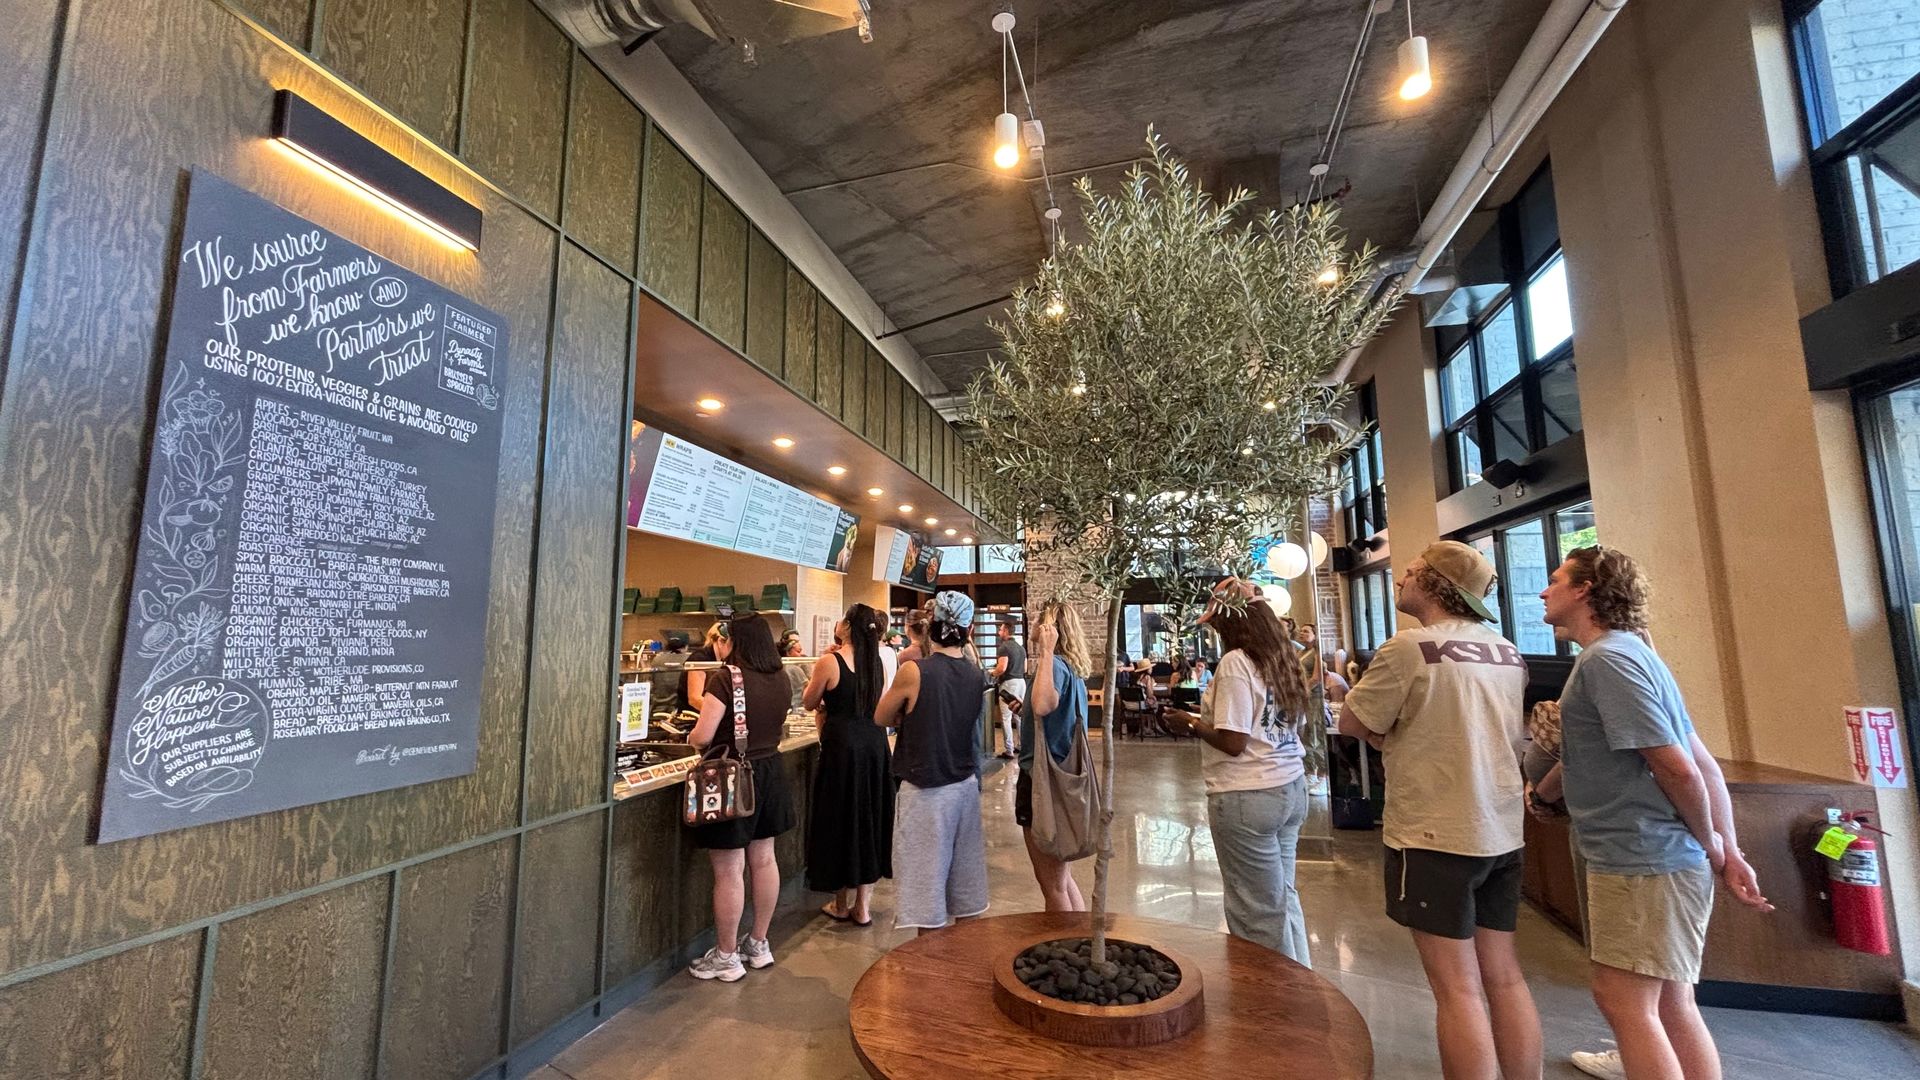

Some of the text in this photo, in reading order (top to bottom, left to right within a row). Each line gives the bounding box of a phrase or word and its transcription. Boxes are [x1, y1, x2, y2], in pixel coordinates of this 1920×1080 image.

[183, 230, 326, 288] We source
[215, 256, 381, 348] from Farmers
[263, 281, 402, 344] we know AND
[451, 310, 492, 335] FEATURED
[453, 321, 486, 342] FARMER
[317, 303, 435, 373] Partners we
[448, 340, 483, 361] Dynasty
[458, 354, 484, 370] Farms
[206, 339, 477, 434] OUR PROTEINS, VEGGIES & GRAINS ARE COOKED
[444, 366, 474, 386] BRUSSELS
[446, 378, 474, 396] SPROUTS
[204, 354, 469, 442] USING 100% EXTRA-VIRGIN OLIVE & AVOCADO OILS
[252, 409, 299, 428] AVOCADO
[252, 419, 281, 434] BASIL
[254, 398, 290, 416] APPLES
[300, 410, 325, 425] RIVER
[326, 418, 355, 433] VALLEY
[382, 434, 392, 444] WA
[249, 438, 342, 467] CILANTRO CHURCH
[251, 428, 378, 465] CARROTS BOLTHOUSE FRESH
[248, 448, 369, 481] CRISPY SHALLOTS ROLAND
[246, 469, 395, 505] GRAPE TOMATOES LIPMAN FAMILY
[247, 459, 388, 494] CUCUMBERS LIPMAN FAMILY
[243, 489, 371, 518] ORGANIC ARUGULA CHURCH
[246, 479, 365, 508] HAND-CHOPPED ROMAINE
[240, 510, 385, 539] ORGANIC SPRING MIX CHURCH
[242, 499, 394, 531] ORGANIC BABY SPINACH CHURCH
[239, 531, 305, 547] RED CABBAGE
[240, 520, 363, 545] ORGANIC SHREDDED KALE
[236, 551, 316, 567] SPICY BROCCOLI
[238, 541, 282, 554] ROASTED
[284, 546, 316, 558] SWEET
[318, 550, 357, 562] POTATOES
[364, 555, 379, 564] THE
[381, 557, 401, 566] RUBY
[234, 563, 399, 584] WARM PORTOBELLO MIX GIORGIO FRESH
[274, 575, 386, 592] PARMESAN RAISON
[231, 594, 309, 607] CRISPY ONIONS
[232, 583, 338, 598] CRISPY RICE RAISON
[230, 604, 277, 615] ALMONDS
[226, 625, 386, 637] ORGANIC ROASTED TOFU HOUSE
[229, 615, 334, 627] ORGANIC CHICKPEAS
[224, 636, 318, 647] ORGANIC QUINOA
[224, 647, 334, 657] WHITE RICE ROYAL
[223, 658, 278, 668] WILD RICE
[246, 665, 370, 678] SAUCE MOTHERLODE
[258, 677, 305, 689] HUMMUS
[266, 681, 414, 699] ORGANIC MAPLE SYRUP BUTTERNUT
[143, 681, 224, 712] Mother
[270, 693, 377, 708] AVOCADO MAVERIK
[272, 702, 364, 718] EXTRA-VIRGIN OLIVE
[273, 708, 400, 729] BREAD BREAD BAKING
[273, 719, 387, 739] ROSEMARY FOCACCIA BREAD
[1870, 716, 1892, 726] FIRE
[132, 712, 222, 766] Happens!
[161, 728, 253, 762] OUR SUPPLIERS ARE
[164, 738, 256, 773] SUBJECT TO CHANGE
[165, 746, 262, 787] BASED ON AVAILABILITY
